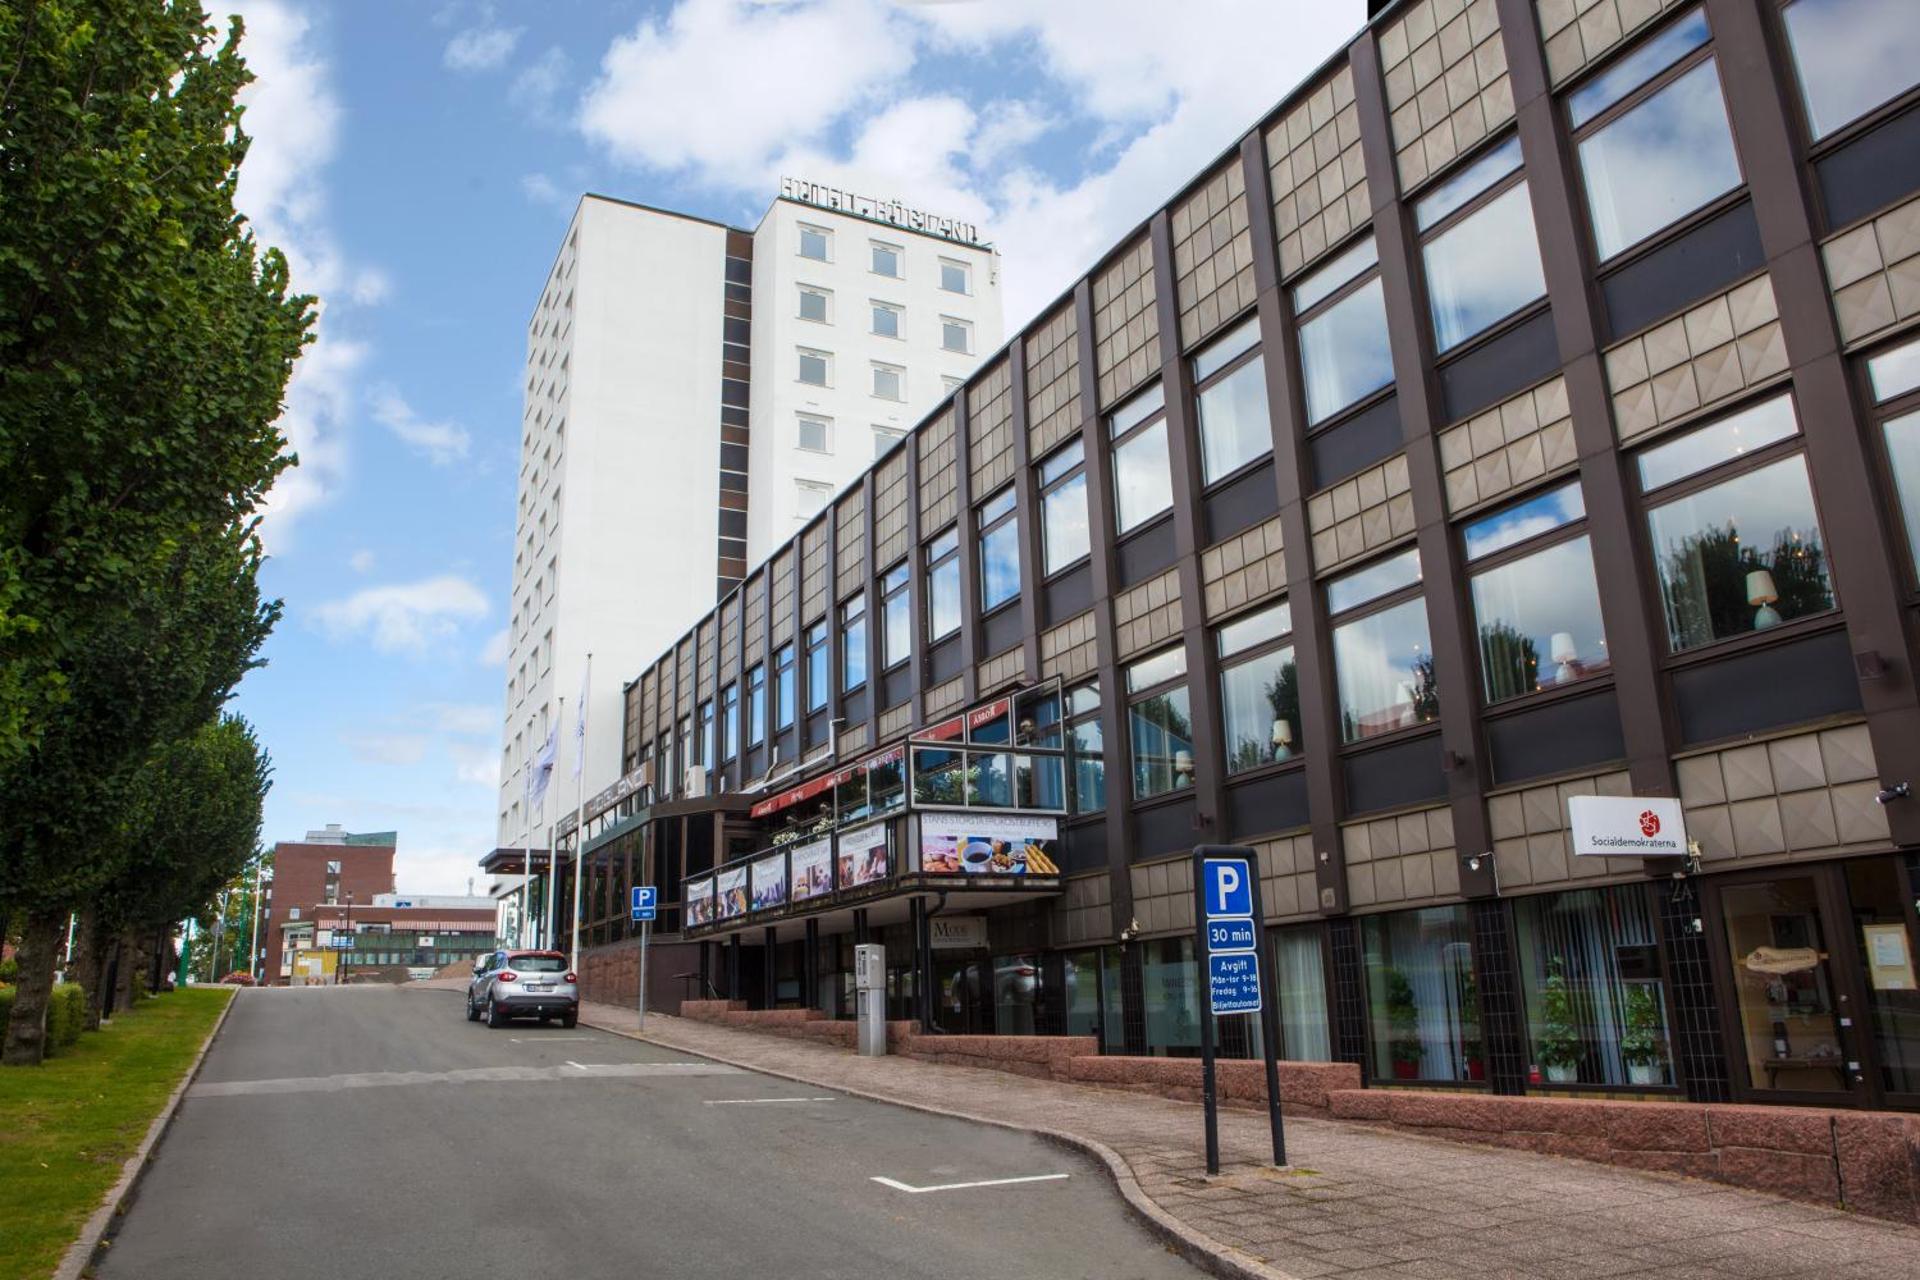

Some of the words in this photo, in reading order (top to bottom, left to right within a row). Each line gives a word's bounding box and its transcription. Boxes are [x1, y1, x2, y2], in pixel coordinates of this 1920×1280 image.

[1591, 835, 1677, 849] Socialdemokraterna
[1217, 866, 1240, 911] P
[638, 889, 651, 906] P
[1211, 928, 1228, 942] 30
[1231, 928, 1252, 942] min
[1220, 959, 1248, 974] Avgift
[1211, 986, 1237, 997] Fredag
[1242, 985, 1258, 994] 9-16
